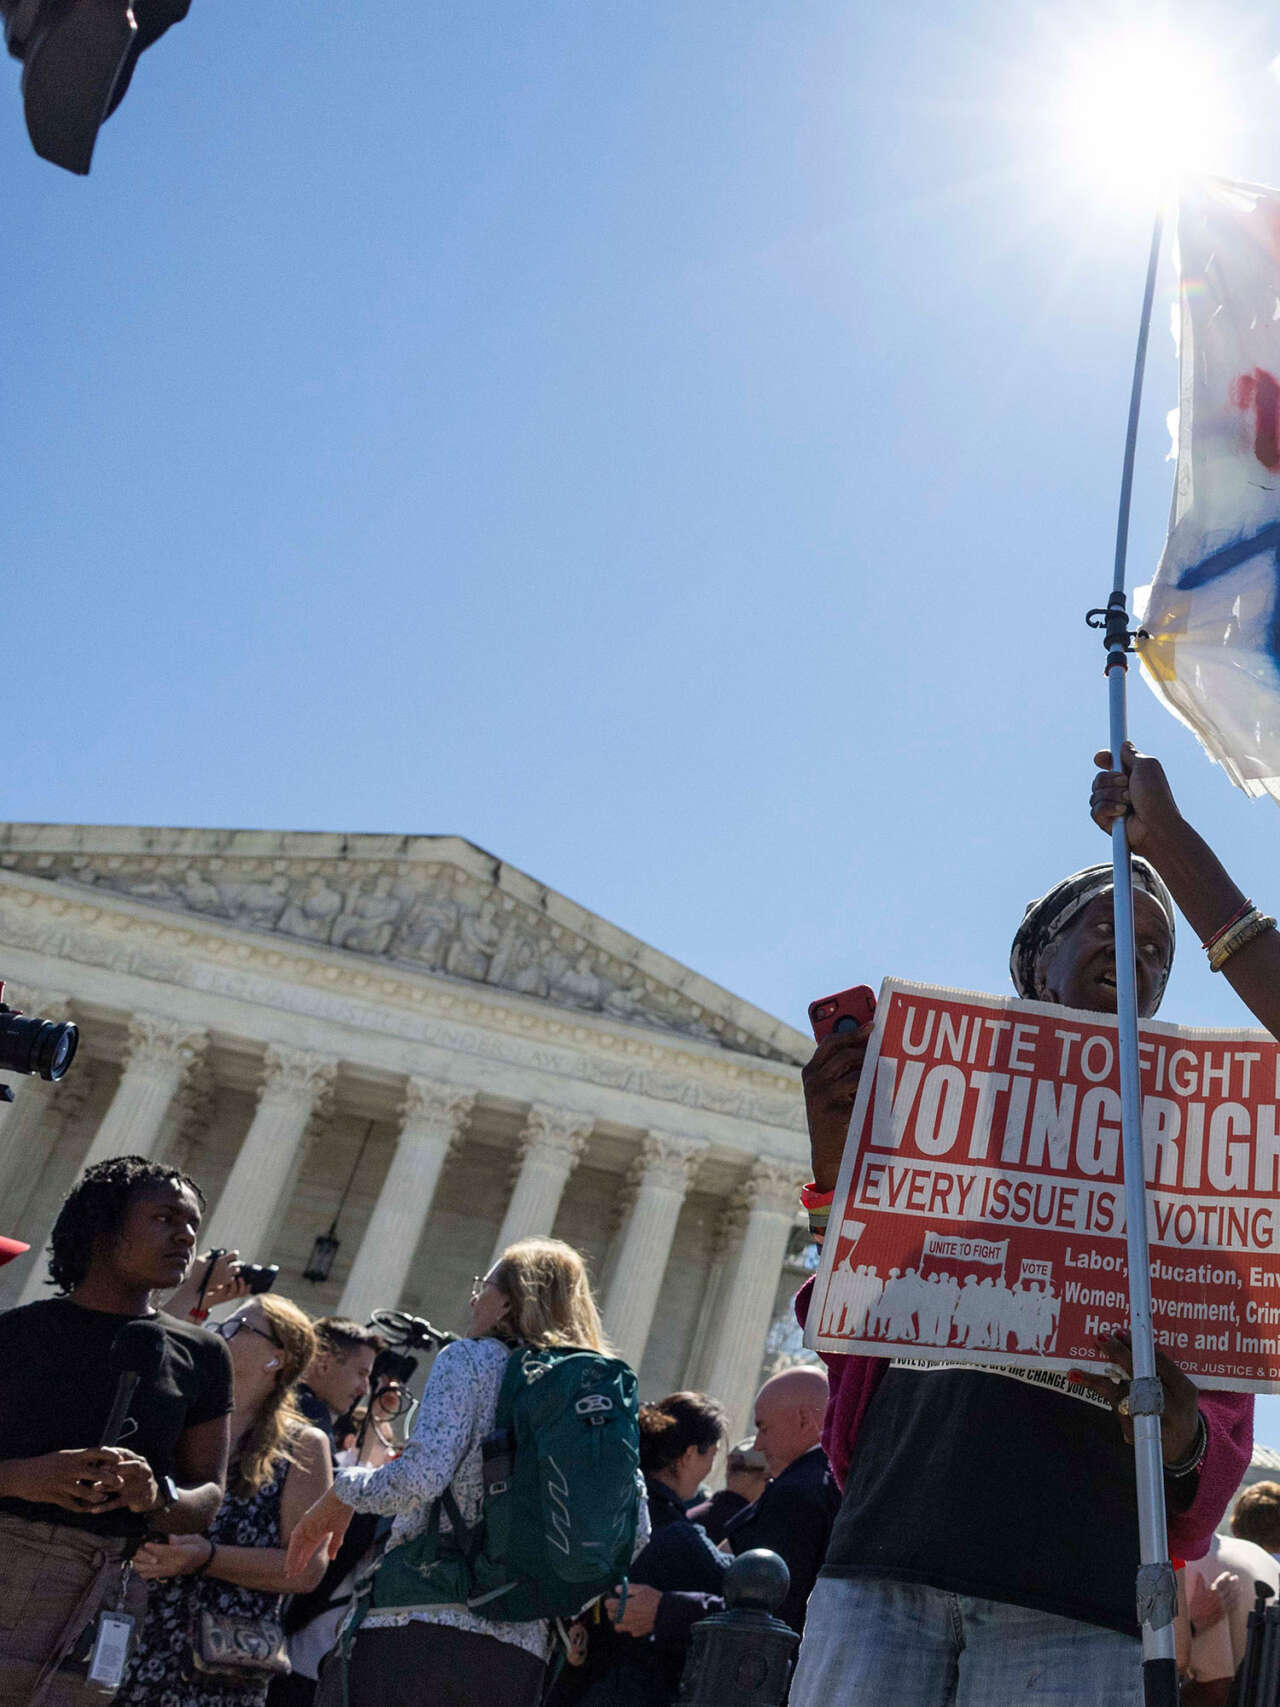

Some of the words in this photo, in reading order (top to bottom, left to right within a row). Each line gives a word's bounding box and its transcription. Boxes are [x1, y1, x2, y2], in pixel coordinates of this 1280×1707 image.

[901, 1005, 1040, 1072] UNITE
[1056, 1030, 1114, 1082] TO
[869, 1056, 1121, 1177] VOTING
[859, 1163, 977, 1215] EVERY
[980, 1176, 1080, 1229] ISSUE
[1085, 1191, 1116, 1233] IS
[1154, 1200, 1274, 1249] VOTING
[929, 1240, 957, 1256] UNITE
[960, 1242, 971, 1256] TO
[974, 1244, 1002, 1259] FIGHT
[1064, 1247, 1128, 1278] Labor,
[1150, 1259, 1242, 1289] ducation,
[1022, 1262, 1049, 1276] VOTE
[1065, 1281, 1129, 1314] Women,
[1150, 1298, 1240, 1327] overnment,
[1195, 1331, 1229, 1351] and
[1026, 1368, 1068, 1391] CHANGE
[1069, 1346, 1096, 1358] SOS
[1201, 1361, 1253, 1376] JUSTICE
[1256, 1367, 1266, 1378] &
